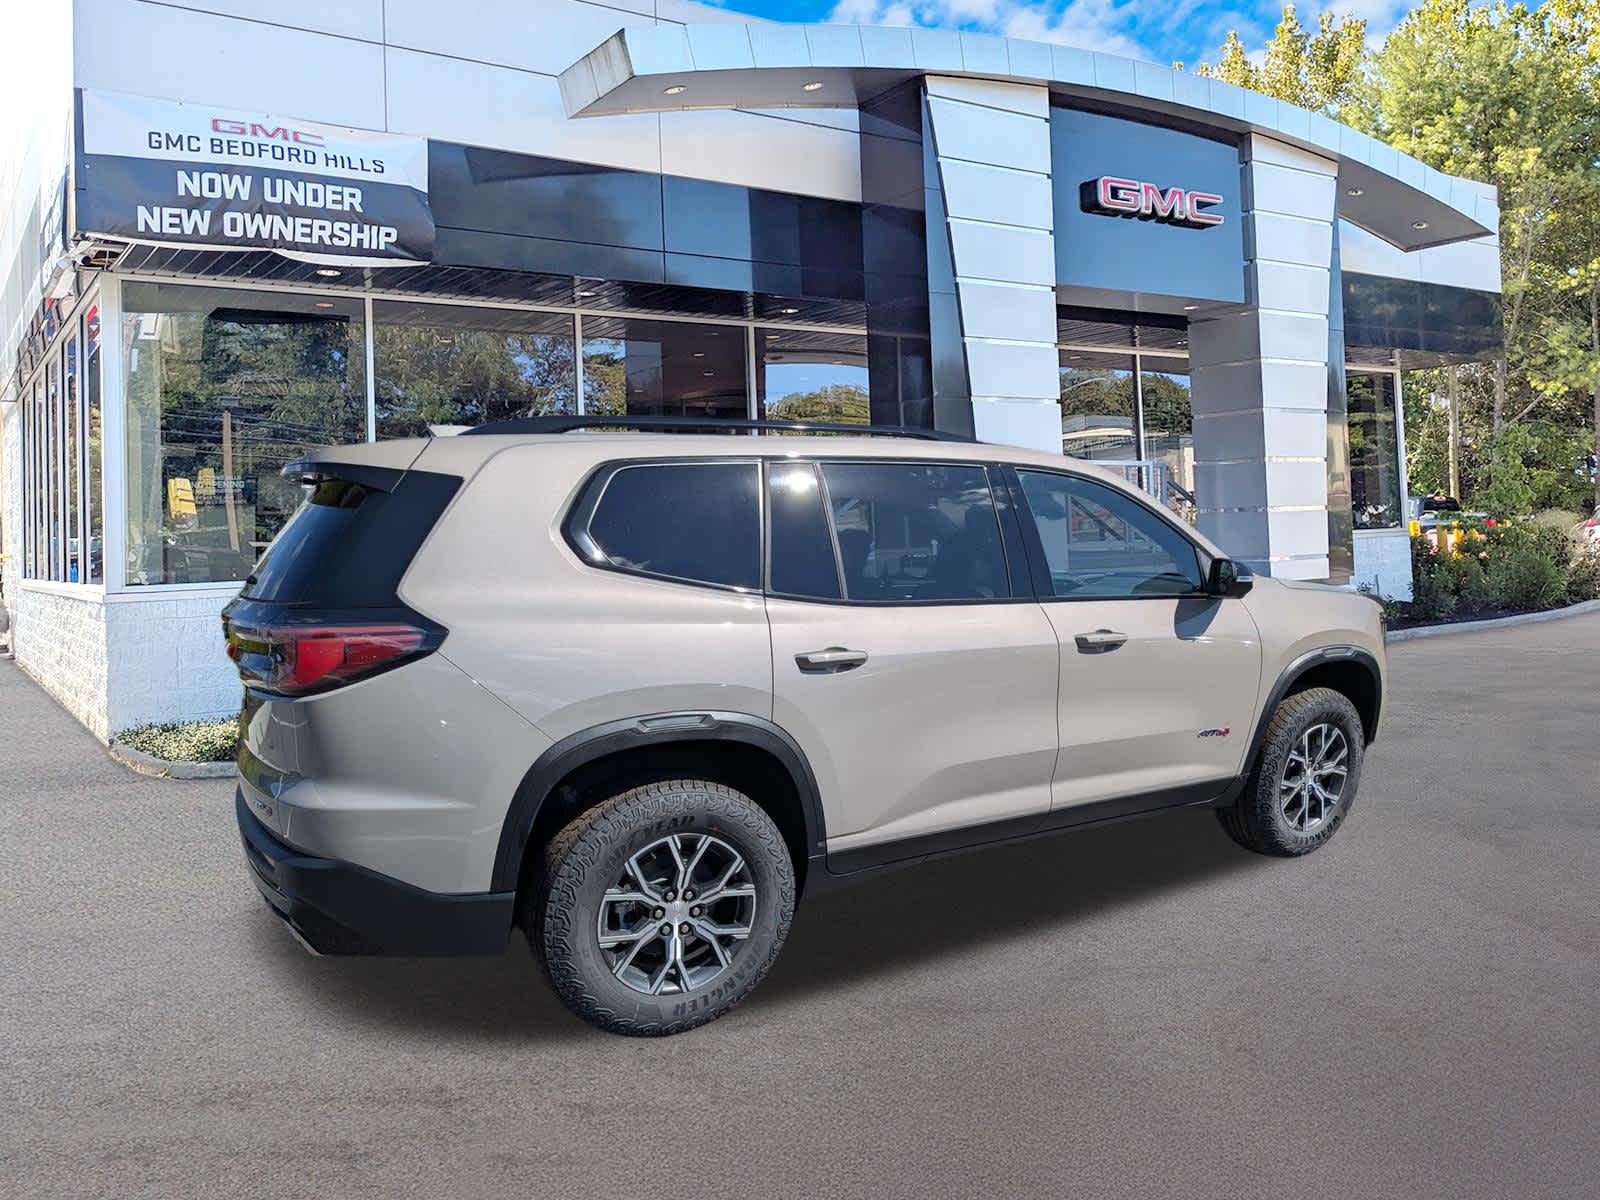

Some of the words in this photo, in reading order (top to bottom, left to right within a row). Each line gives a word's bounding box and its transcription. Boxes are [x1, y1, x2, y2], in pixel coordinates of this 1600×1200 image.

[147, 131, 202, 153] GMC
[210, 137, 316, 166] BEDFORD
[325, 152, 385, 174] HILLS
[210, 118, 326, 148] GMC
[177, 170, 252, 201] NOW
[263, 176, 363, 213] UNDER
[1097, 175, 1225, 225] GMC
[136, 205, 212, 236] NEW
[223, 211, 398, 250] OWNERSHIP
